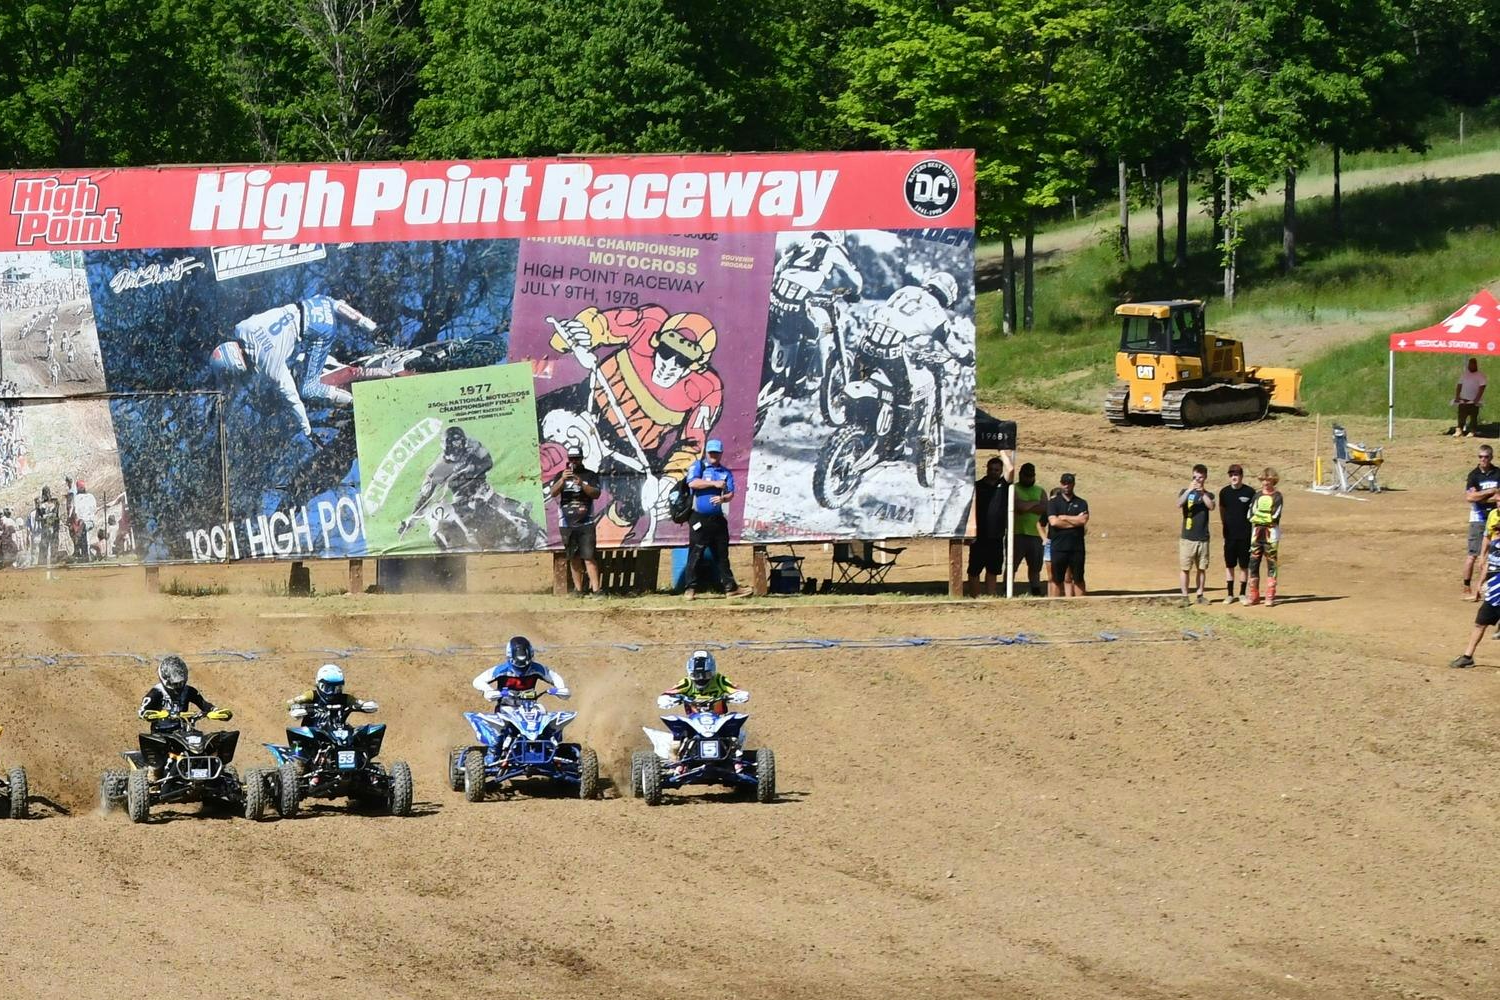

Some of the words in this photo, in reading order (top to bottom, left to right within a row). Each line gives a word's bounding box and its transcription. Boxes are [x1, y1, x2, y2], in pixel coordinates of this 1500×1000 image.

[11, 177, 99, 218] High
[914, 173, 951, 205] DC
[189, 169, 346, 240] High
[351, 164, 531, 226] Point
[537, 163, 839, 227] Raceway
[16, 207, 121, 246] Point
[596, 237, 699, 259] CHAMPIONSHIP
[721, 254, 754, 263] SOUVENIR
[589, 252, 698, 275] MOTOCROSS
[720, 261, 754, 270] PROGRAM
[523, 262, 564, 279] HIGH
[569, 269, 619, 285] POINT
[624, 273, 705, 294] RACEWAY
[521, 281, 560, 296] JULY
[565, 287, 599, 304] 9TH,
[606, 290, 639, 306] 1978
[1414, 339, 1447, 348] MEDICAL
[1448, 340, 1479, 350] STATION
[1137, 365, 1154, 379] CAT
[449, 395, 484, 406] NATIONAL
[486, 390, 530, 401] MOTOCROSS
[460, 383, 492, 396] 1977
[439, 402, 494, 413] CHAMPIONSHIP
[753, 482, 781, 496] 1980
[874, 503, 915, 524] AMA
[246, 505, 314, 558] HIGH
